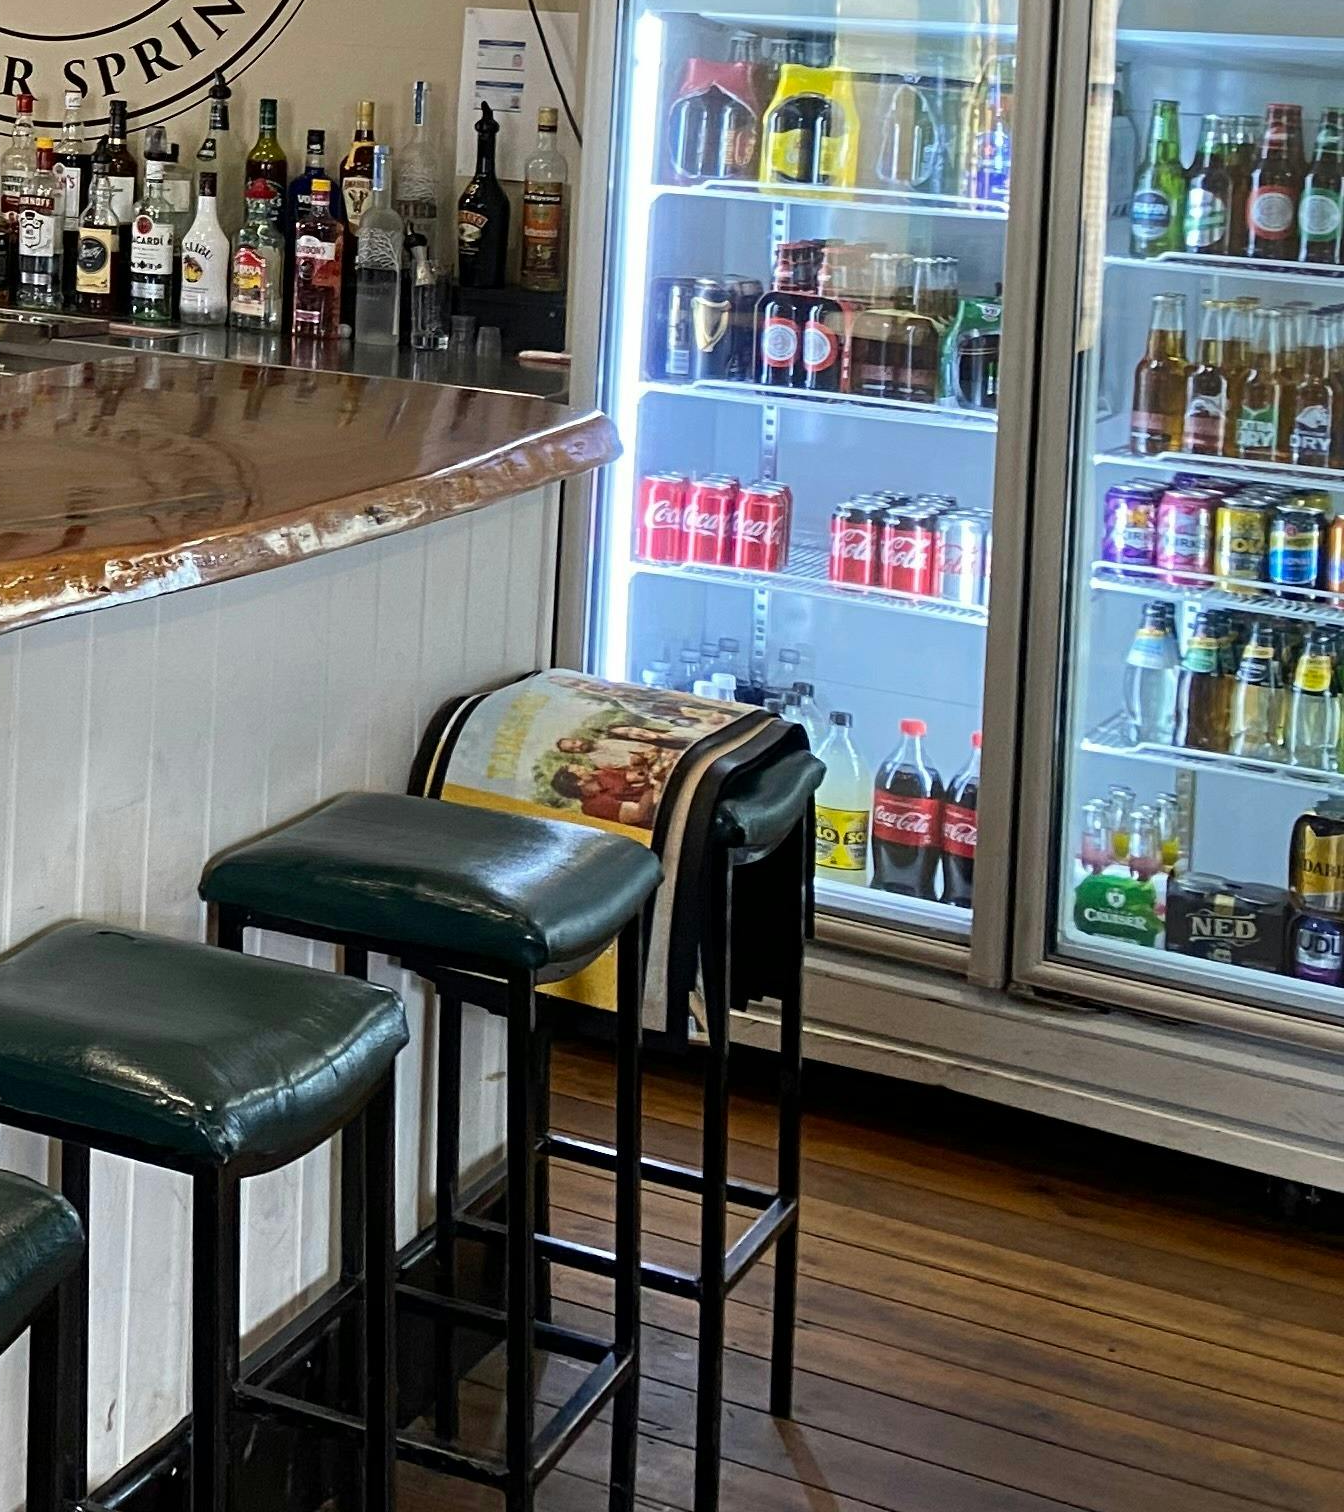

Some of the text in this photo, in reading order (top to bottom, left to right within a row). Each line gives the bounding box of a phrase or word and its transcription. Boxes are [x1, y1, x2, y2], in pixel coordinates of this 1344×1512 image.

[1290, 434, 1331, 451] DRY
[875, 805, 932, 834] Coca-Cola
[1191, 916, 1258, 940] NED
[1300, 932, 1341, 955] UDL
